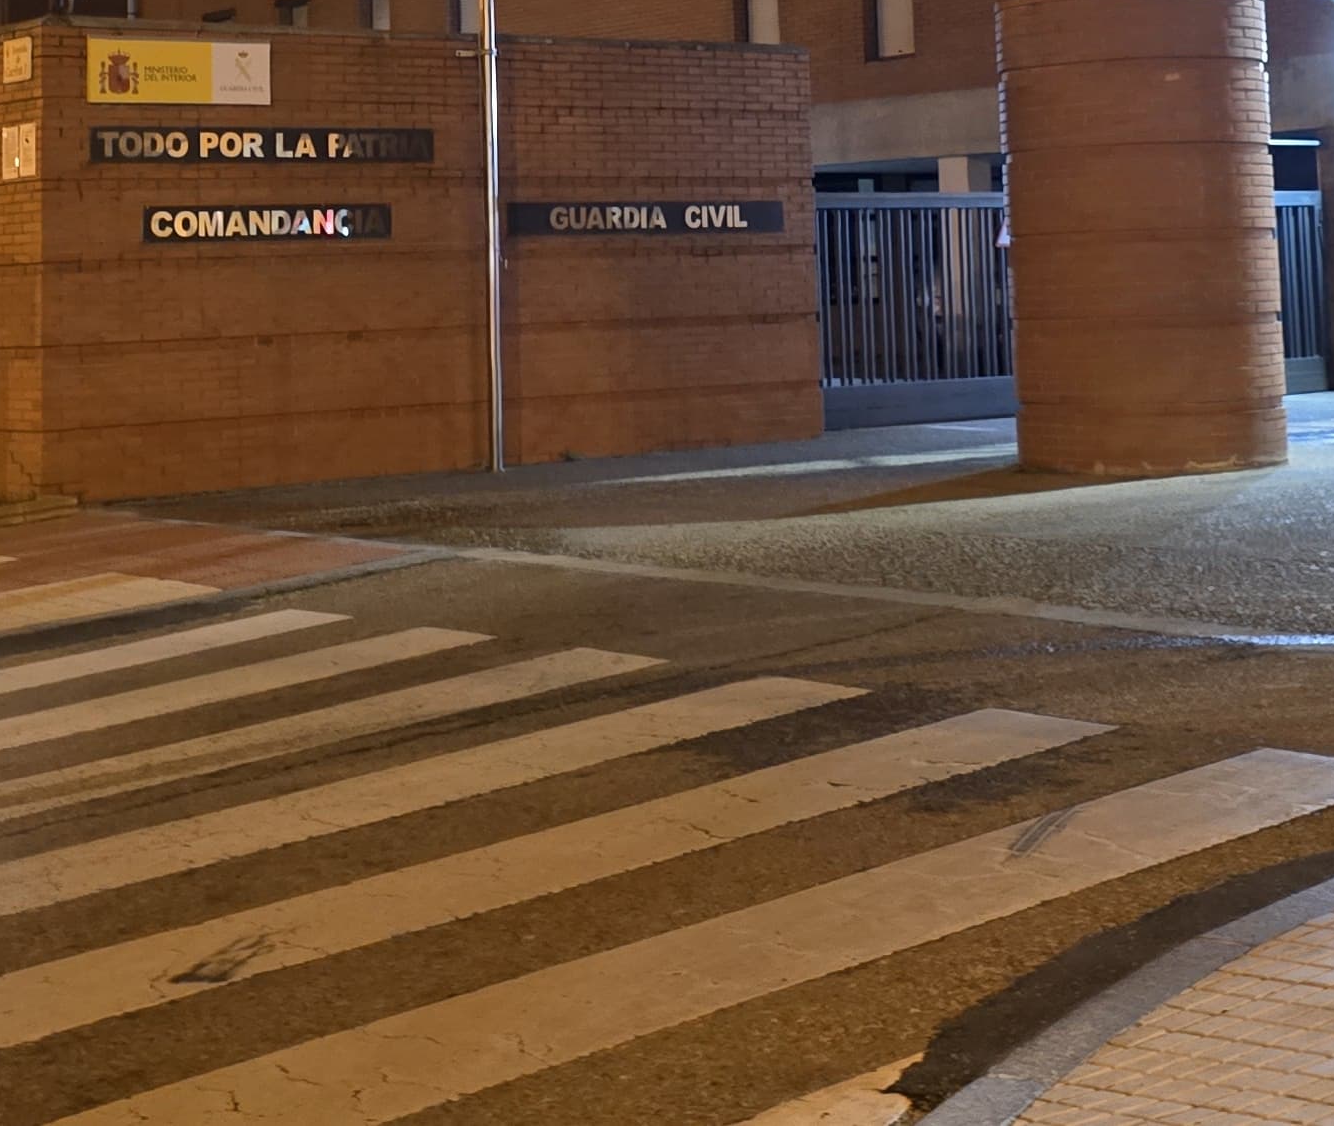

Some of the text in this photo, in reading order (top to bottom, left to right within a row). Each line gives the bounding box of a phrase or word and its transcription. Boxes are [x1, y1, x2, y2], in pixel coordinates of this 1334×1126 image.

[144, 66, 188, 74] MINISTERIO
[144, 75, 197, 83] DEL INTERIOR
[98, 131, 429, 159] TODO POR LA PATRIA
[150, 209, 387, 238] COMANDANCIA
[549, 205, 748, 230] GUARDIA CIVIL
